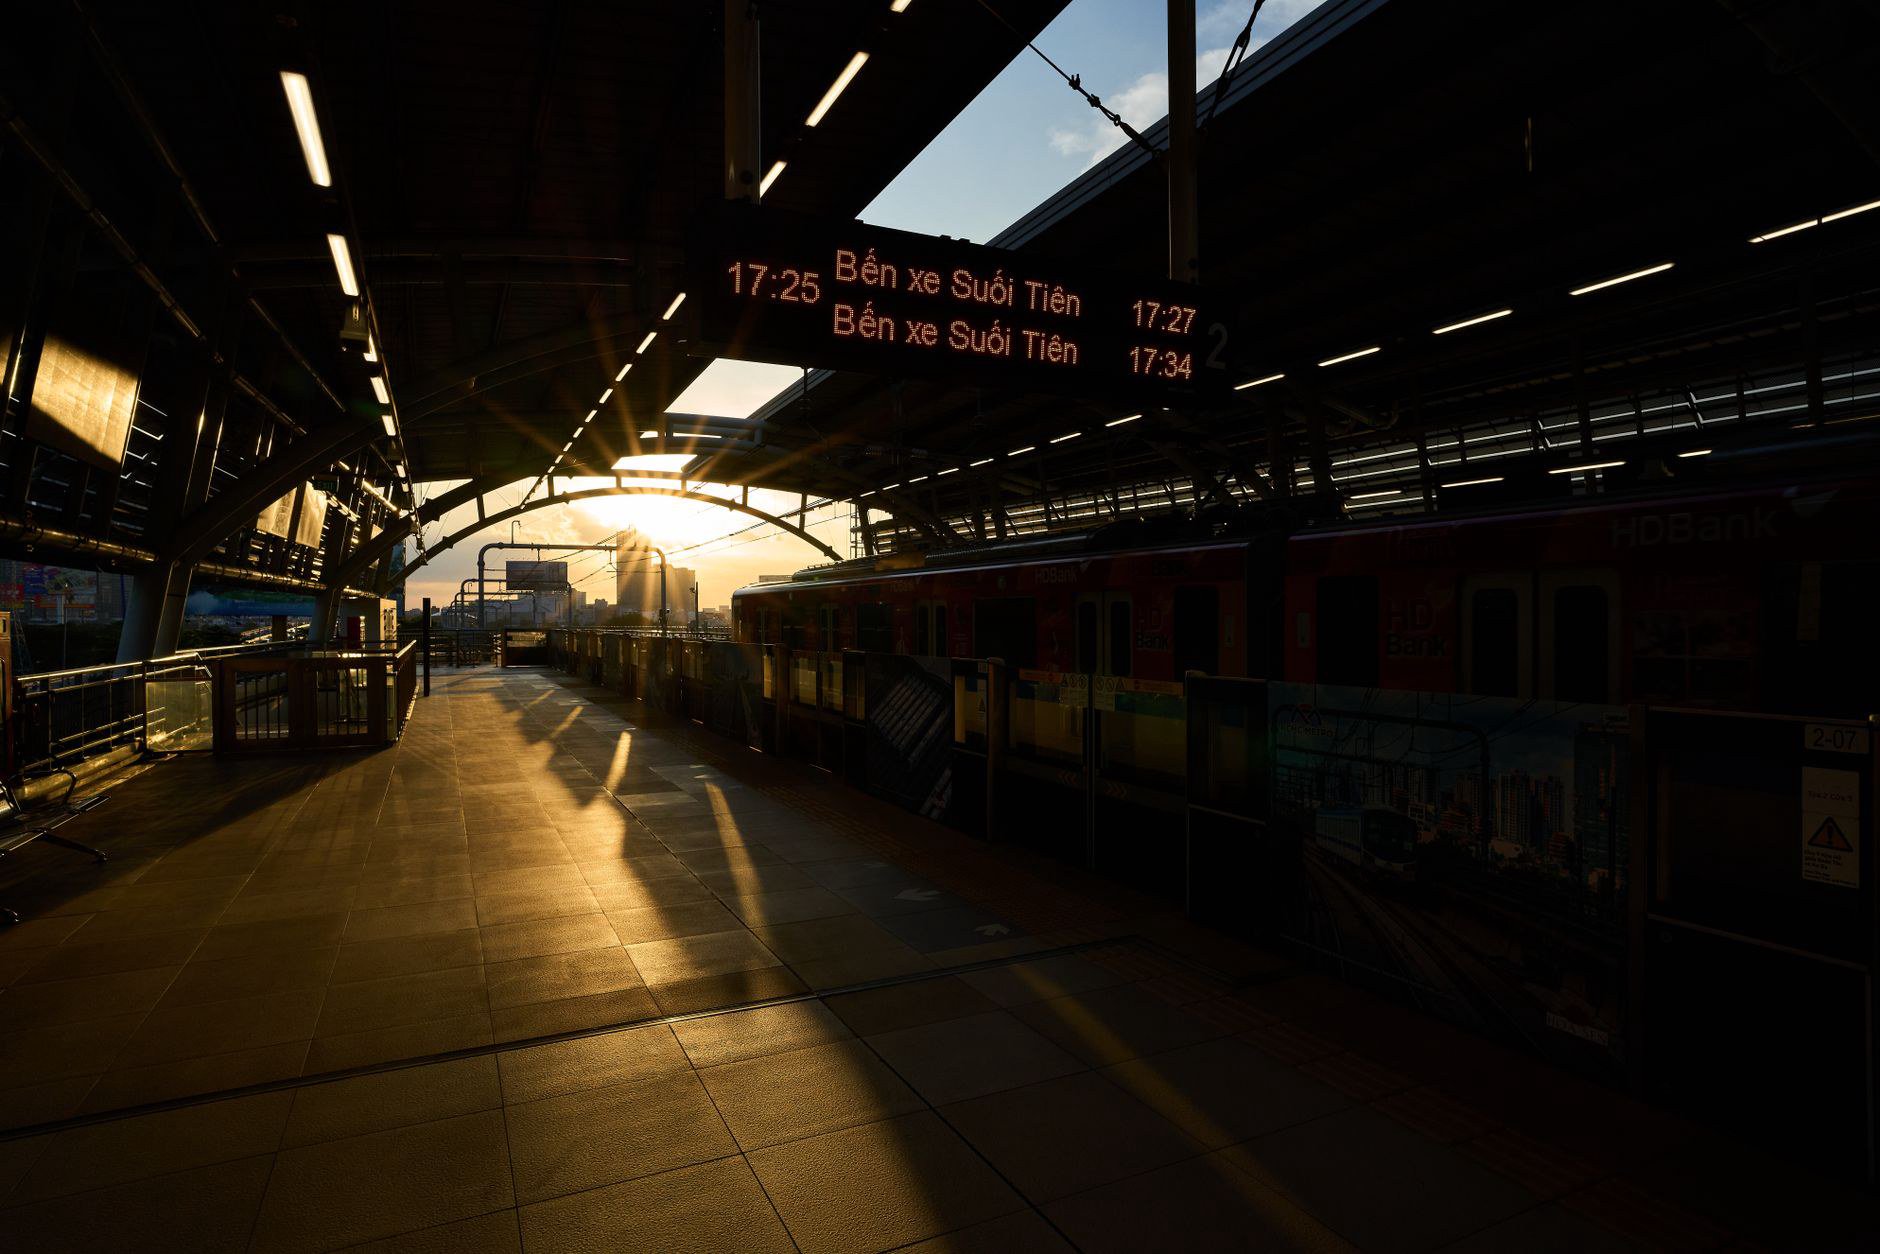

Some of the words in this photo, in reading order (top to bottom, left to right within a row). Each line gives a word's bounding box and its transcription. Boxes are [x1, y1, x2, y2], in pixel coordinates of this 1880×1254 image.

[728, 261, 821, 303] 17:25
[836, 247, 897, 289] Bến
[908, 268, 941, 294] xe
[951, 269, 1014, 307] Suối
[1024, 280, 1080, 317] Tiên
[833, 300, 895, 341] Bến
[906, 320, 938, 346] xe
[948, 319, 1011, 356] Suối
[1022, 330, 1078, 365] Tiên
[1133, 300, 1196, 334] 17:27
[1130, 346, 1192, 380] 17:34
[1205, 322, 1229, 371] 2
[1609, 506, 1779, 549] HDBank
[1136, 631, 1168, 650] Bank
[1386, 633, 1447, 657] Bank
[1813, 728, 1857, 750] 2-07
